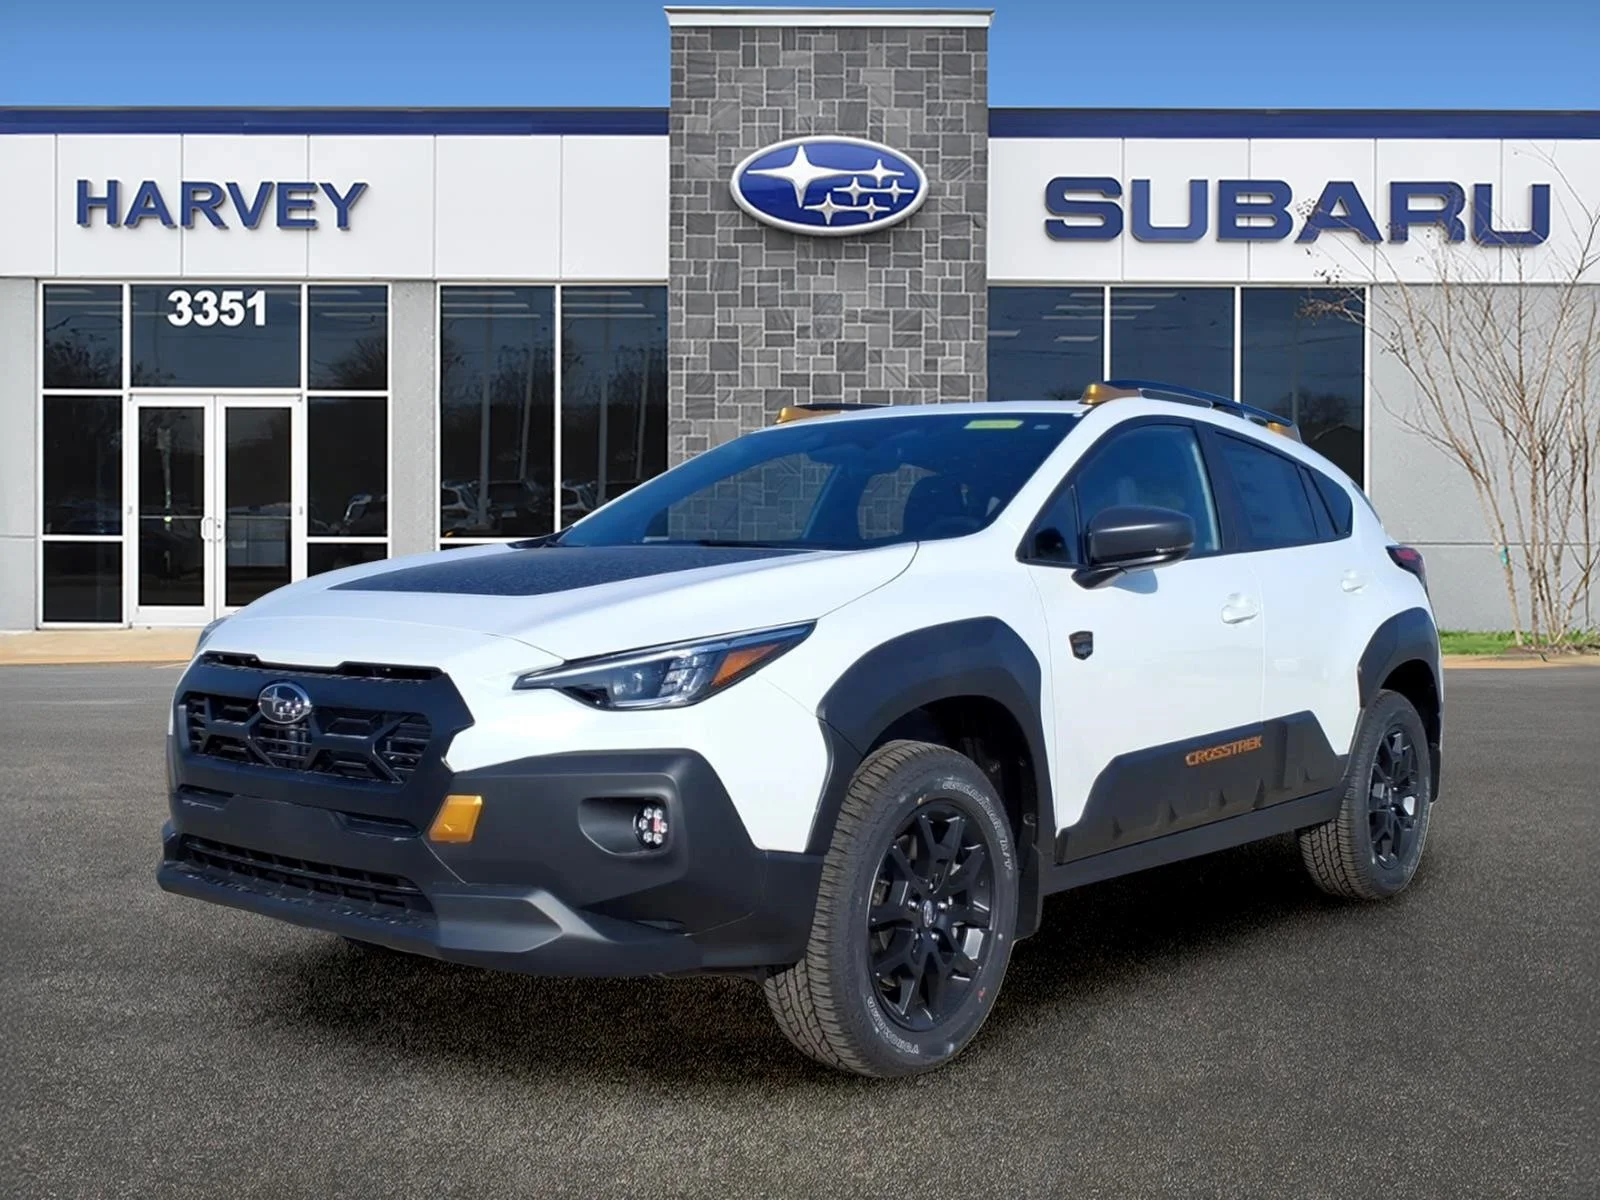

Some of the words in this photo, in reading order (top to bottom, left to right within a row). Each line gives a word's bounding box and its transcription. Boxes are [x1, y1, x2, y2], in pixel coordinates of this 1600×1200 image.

[78, 180, 368, 230] HARVEY
[1044, 177, 1550, 247] SUBARU
[166, 289, 267, 327] 3351
[1185, 735, 1263, 766] CROSSTREK
